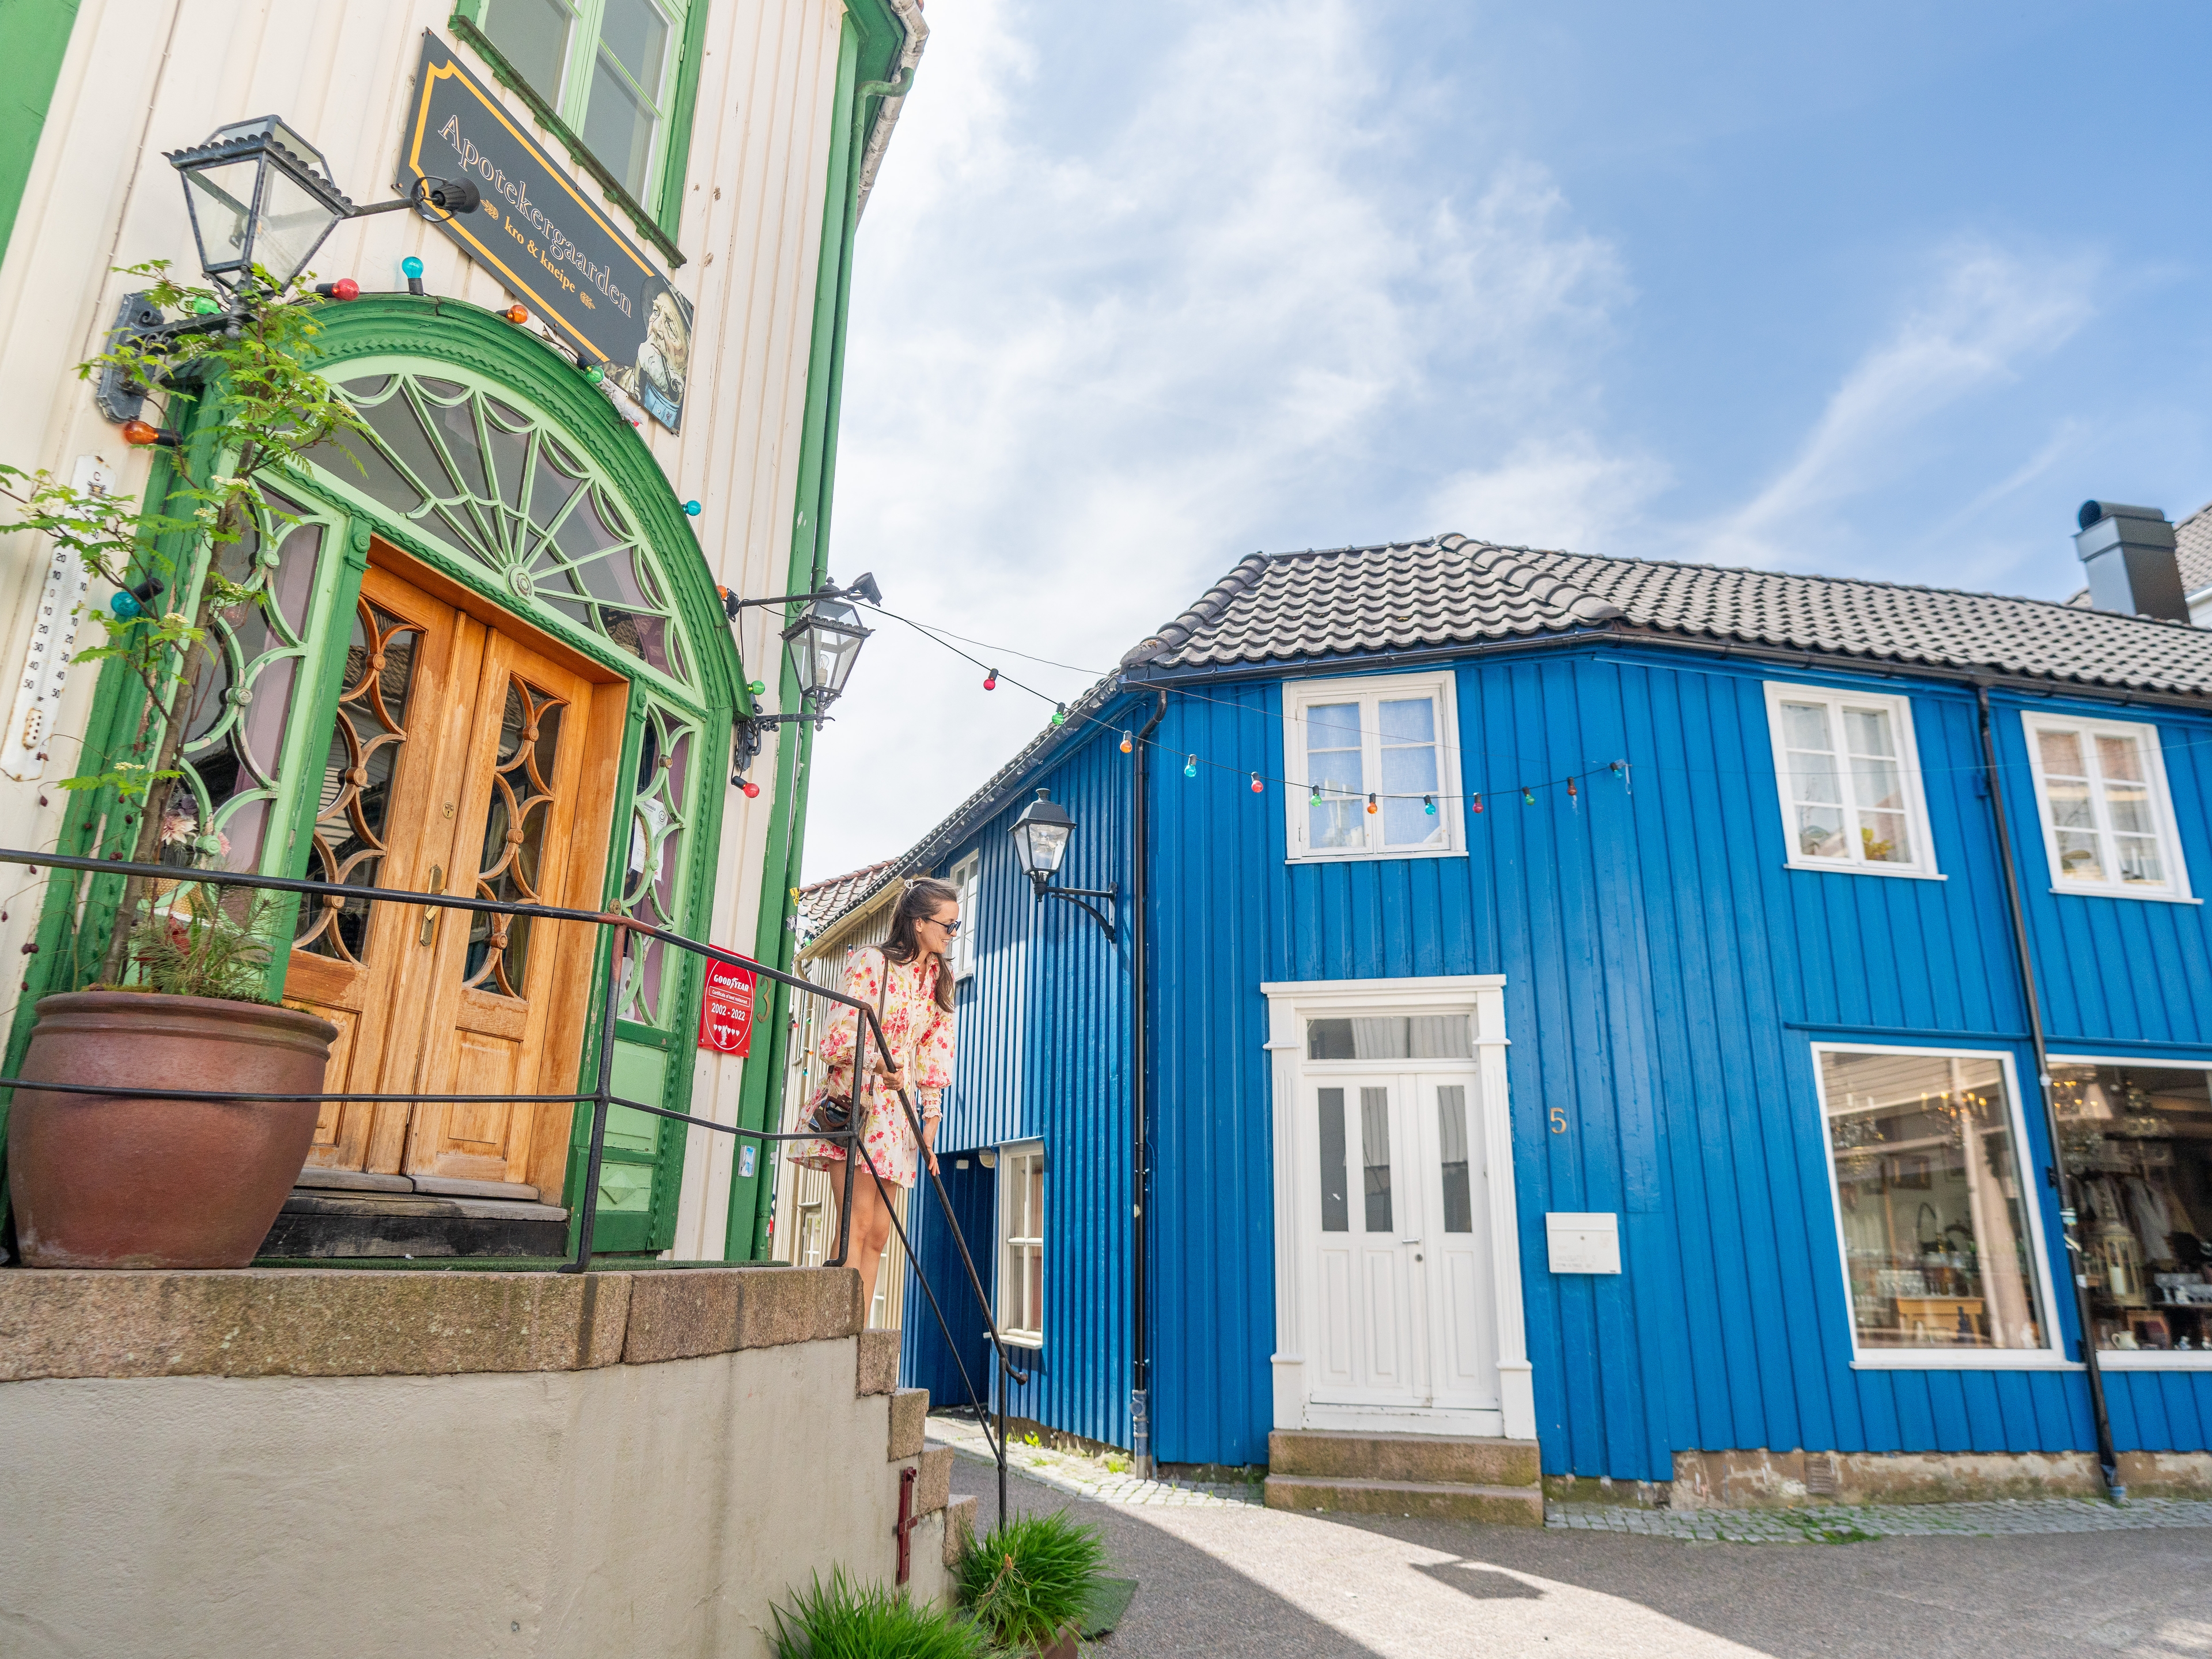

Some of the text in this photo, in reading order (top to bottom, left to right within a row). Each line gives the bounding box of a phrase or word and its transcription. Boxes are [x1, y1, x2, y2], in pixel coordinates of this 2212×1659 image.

[438, 115, 632, 319] Apotekergaarden
[504, 216, 575, 293] kro & kneipe
[56, 552, 66, 563] 20
[52, 570, 61, 580] 10
[80, 581, 87, 591] 10
[50, 589, 55, 597] 0
[44, 605, 52, 616] 10
[71, 617, 78, 626] 10
[38, 624, 48, 634] 20
[65, 634, 74, 644] 20
[33, 642, 43, 652] 30
[60, 652, 69, 662] 30
[29, 661, 39, 670] 40
[56, 671, 65, 680] 40
[24, 679, 33, 689] 50
[51, 688, 60, 698] 50
[713, 974, 749, 993] GOODYEAR
[712, 989, 726, 998] Certificate
[734, 997, 748, 1005] restaurant
[756, 975, 772, 1024] 3
[711, 1002, 726, 1016] 2002
[730, 1008, 745, 1021] 2022
[1549, 1107, 1567, 1135] 5
